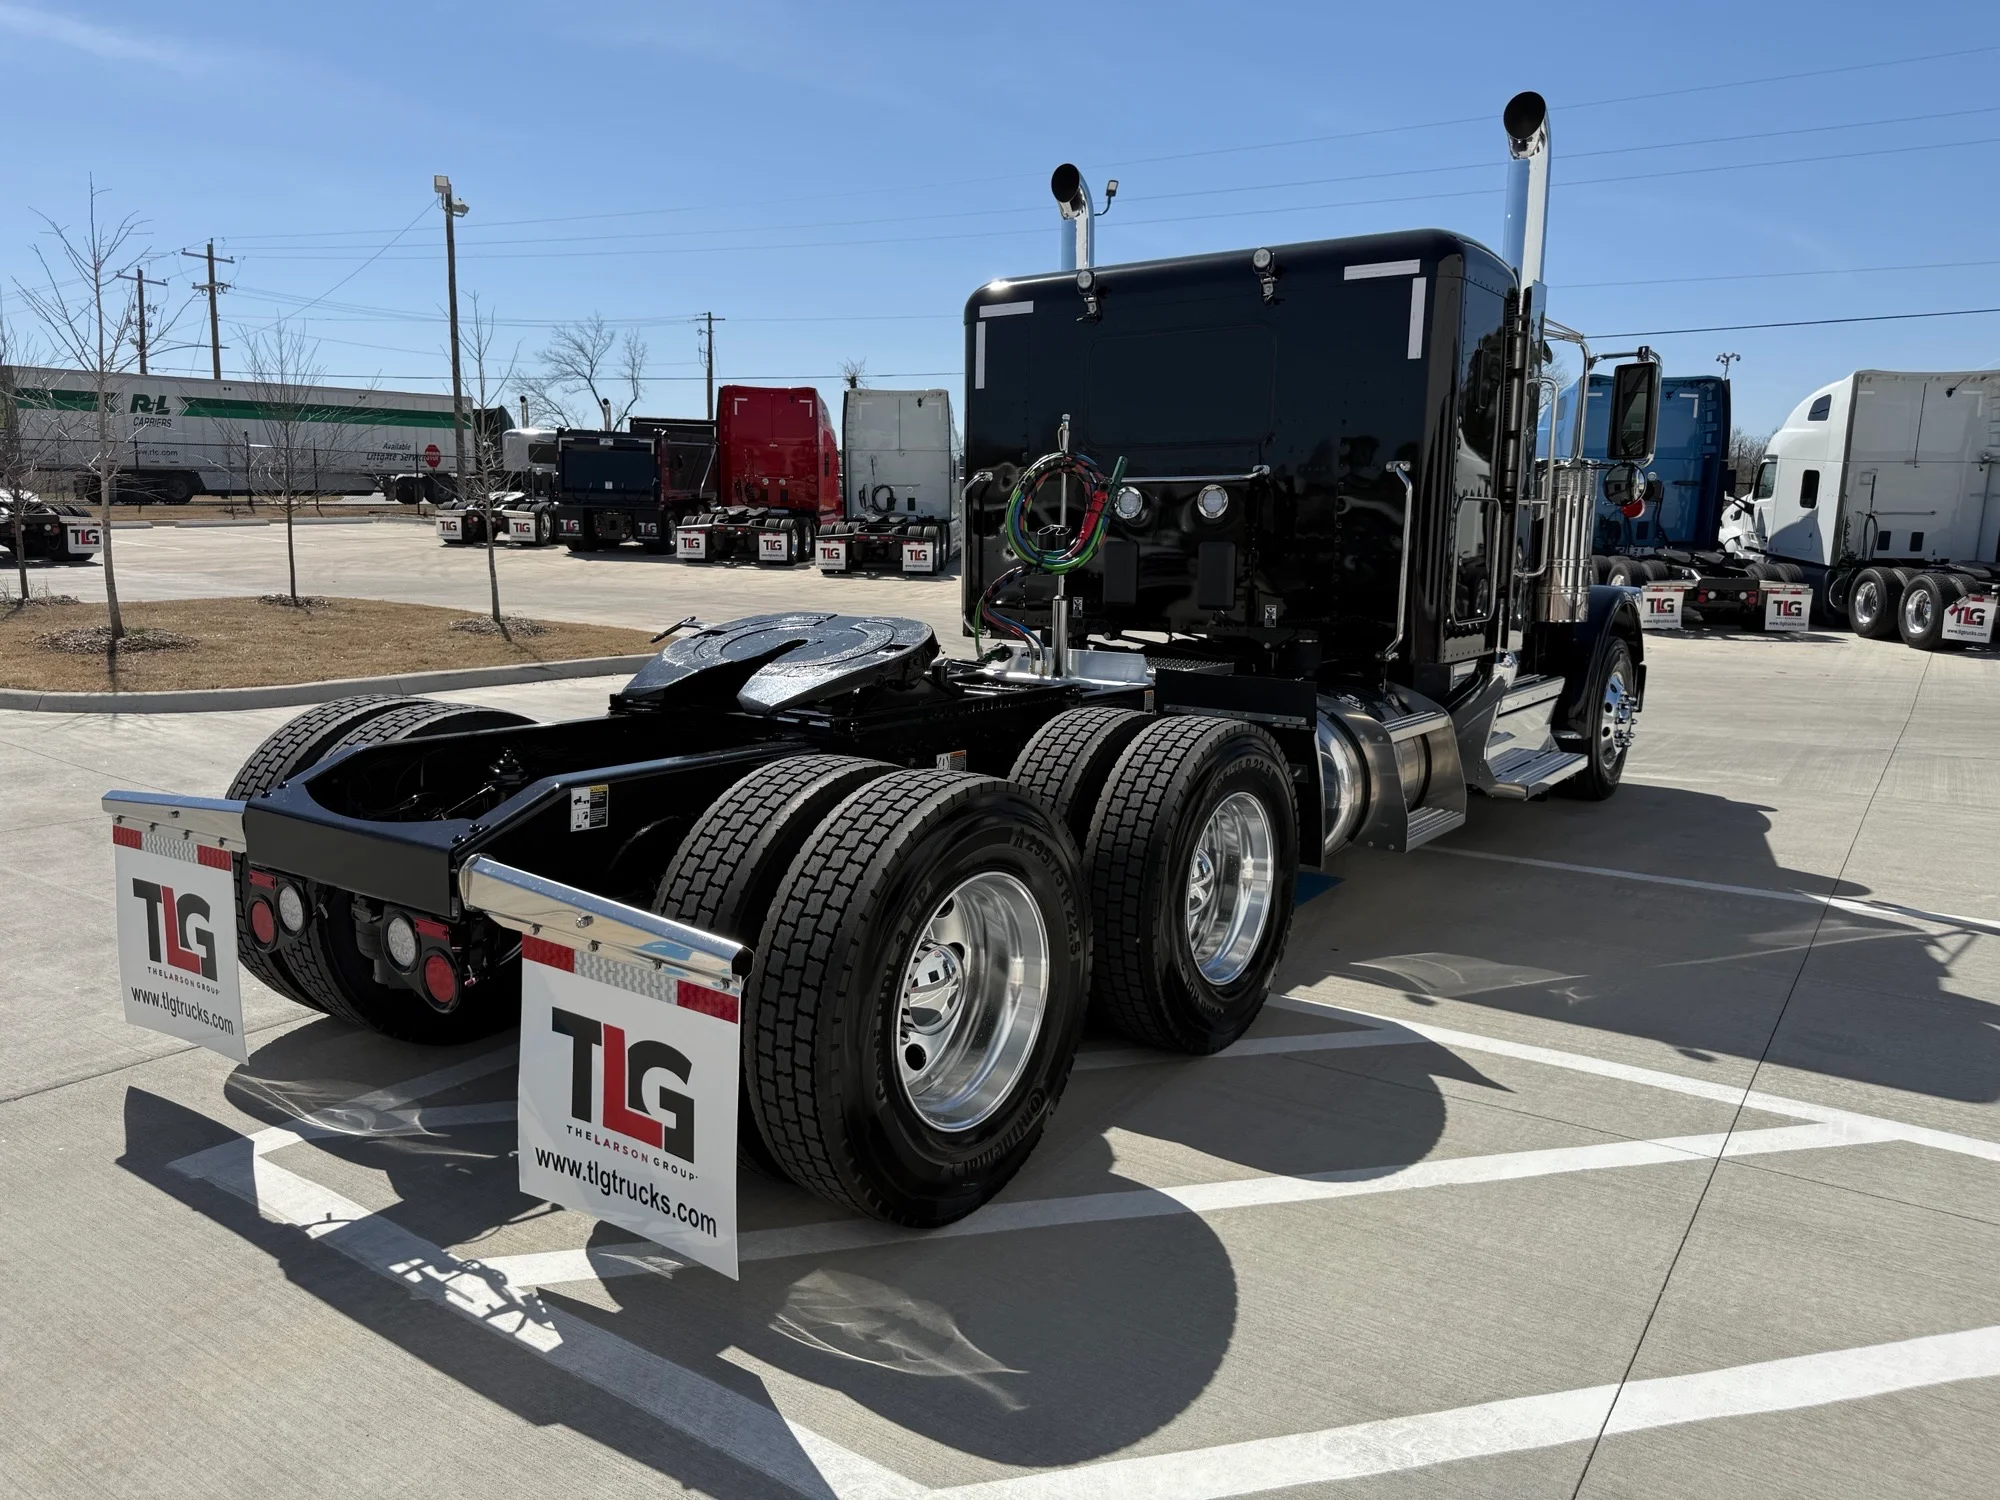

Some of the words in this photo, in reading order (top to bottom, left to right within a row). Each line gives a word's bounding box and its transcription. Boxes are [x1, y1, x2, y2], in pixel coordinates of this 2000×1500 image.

[133, 416, 172, 428] CARRIERS
[129, 448, 178, 456] w.rlc.com
[382, 442, 412, 451] Available
[440, 520, 458, 531] TLG
[513, 522, 531, 533] TLG
[560, 519, 580, 532] TLG
[638, 522, 658, 534] TLG
[70, 529, 100, 545] TLG
[681, 537, 701, 549] TLG
[763, 539, 783, 551] TLG
[820, 547, 840, 560] TLG
[907, 549, 928, 561] TLG
[1646, 597, 1675, 614] TLG
[1773, 600, 1803, 617] TLG
[1955, 606, 1986, 626] TLG
[132, 877, 218, 982] TLG
[147, 966, 163, 979] THE
[163, 970, 195, 988] LARSON
[196, 981, 221, 996] GROUP
[131, 986, 234, 1036] www.tlgtrucks.com
[551, 1006, 695, 1164] TLG
[566, 1124, 593, 1142] THE
[594, 1134, 649, 1163] LARSON
[653, 1157, 695, 1182] GROUP
[535, 1146, 717, 1238] www.tlgtrucks.com
